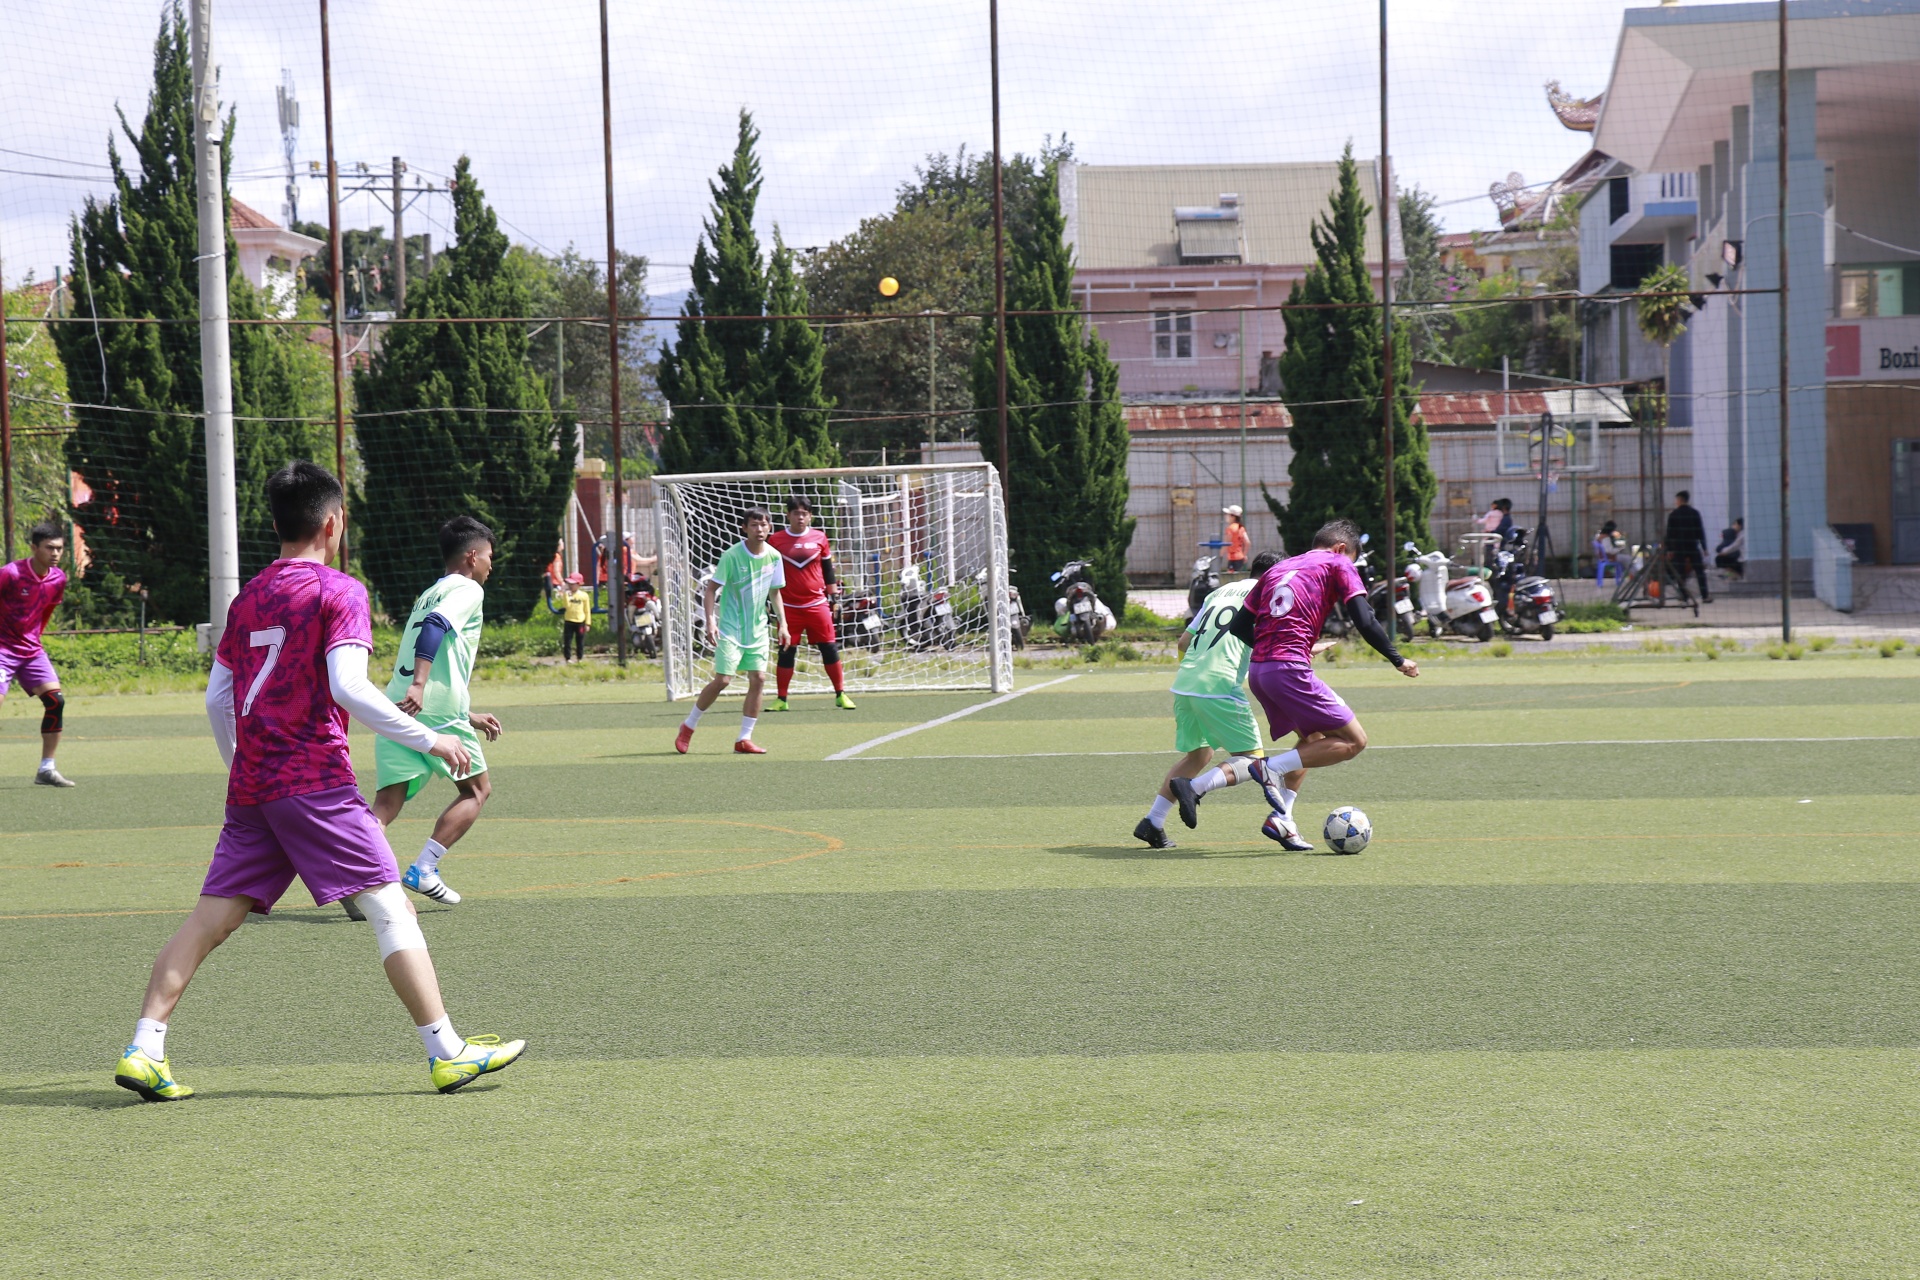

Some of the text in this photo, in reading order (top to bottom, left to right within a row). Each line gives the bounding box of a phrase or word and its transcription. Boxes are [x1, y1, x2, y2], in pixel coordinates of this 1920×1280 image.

[1880, 346, 1920, 369] Boxi
[1269, 569, 1300, 618] 6
[1193, 605, 1239, 651] 49
[241, 625, 286, 717] 7
